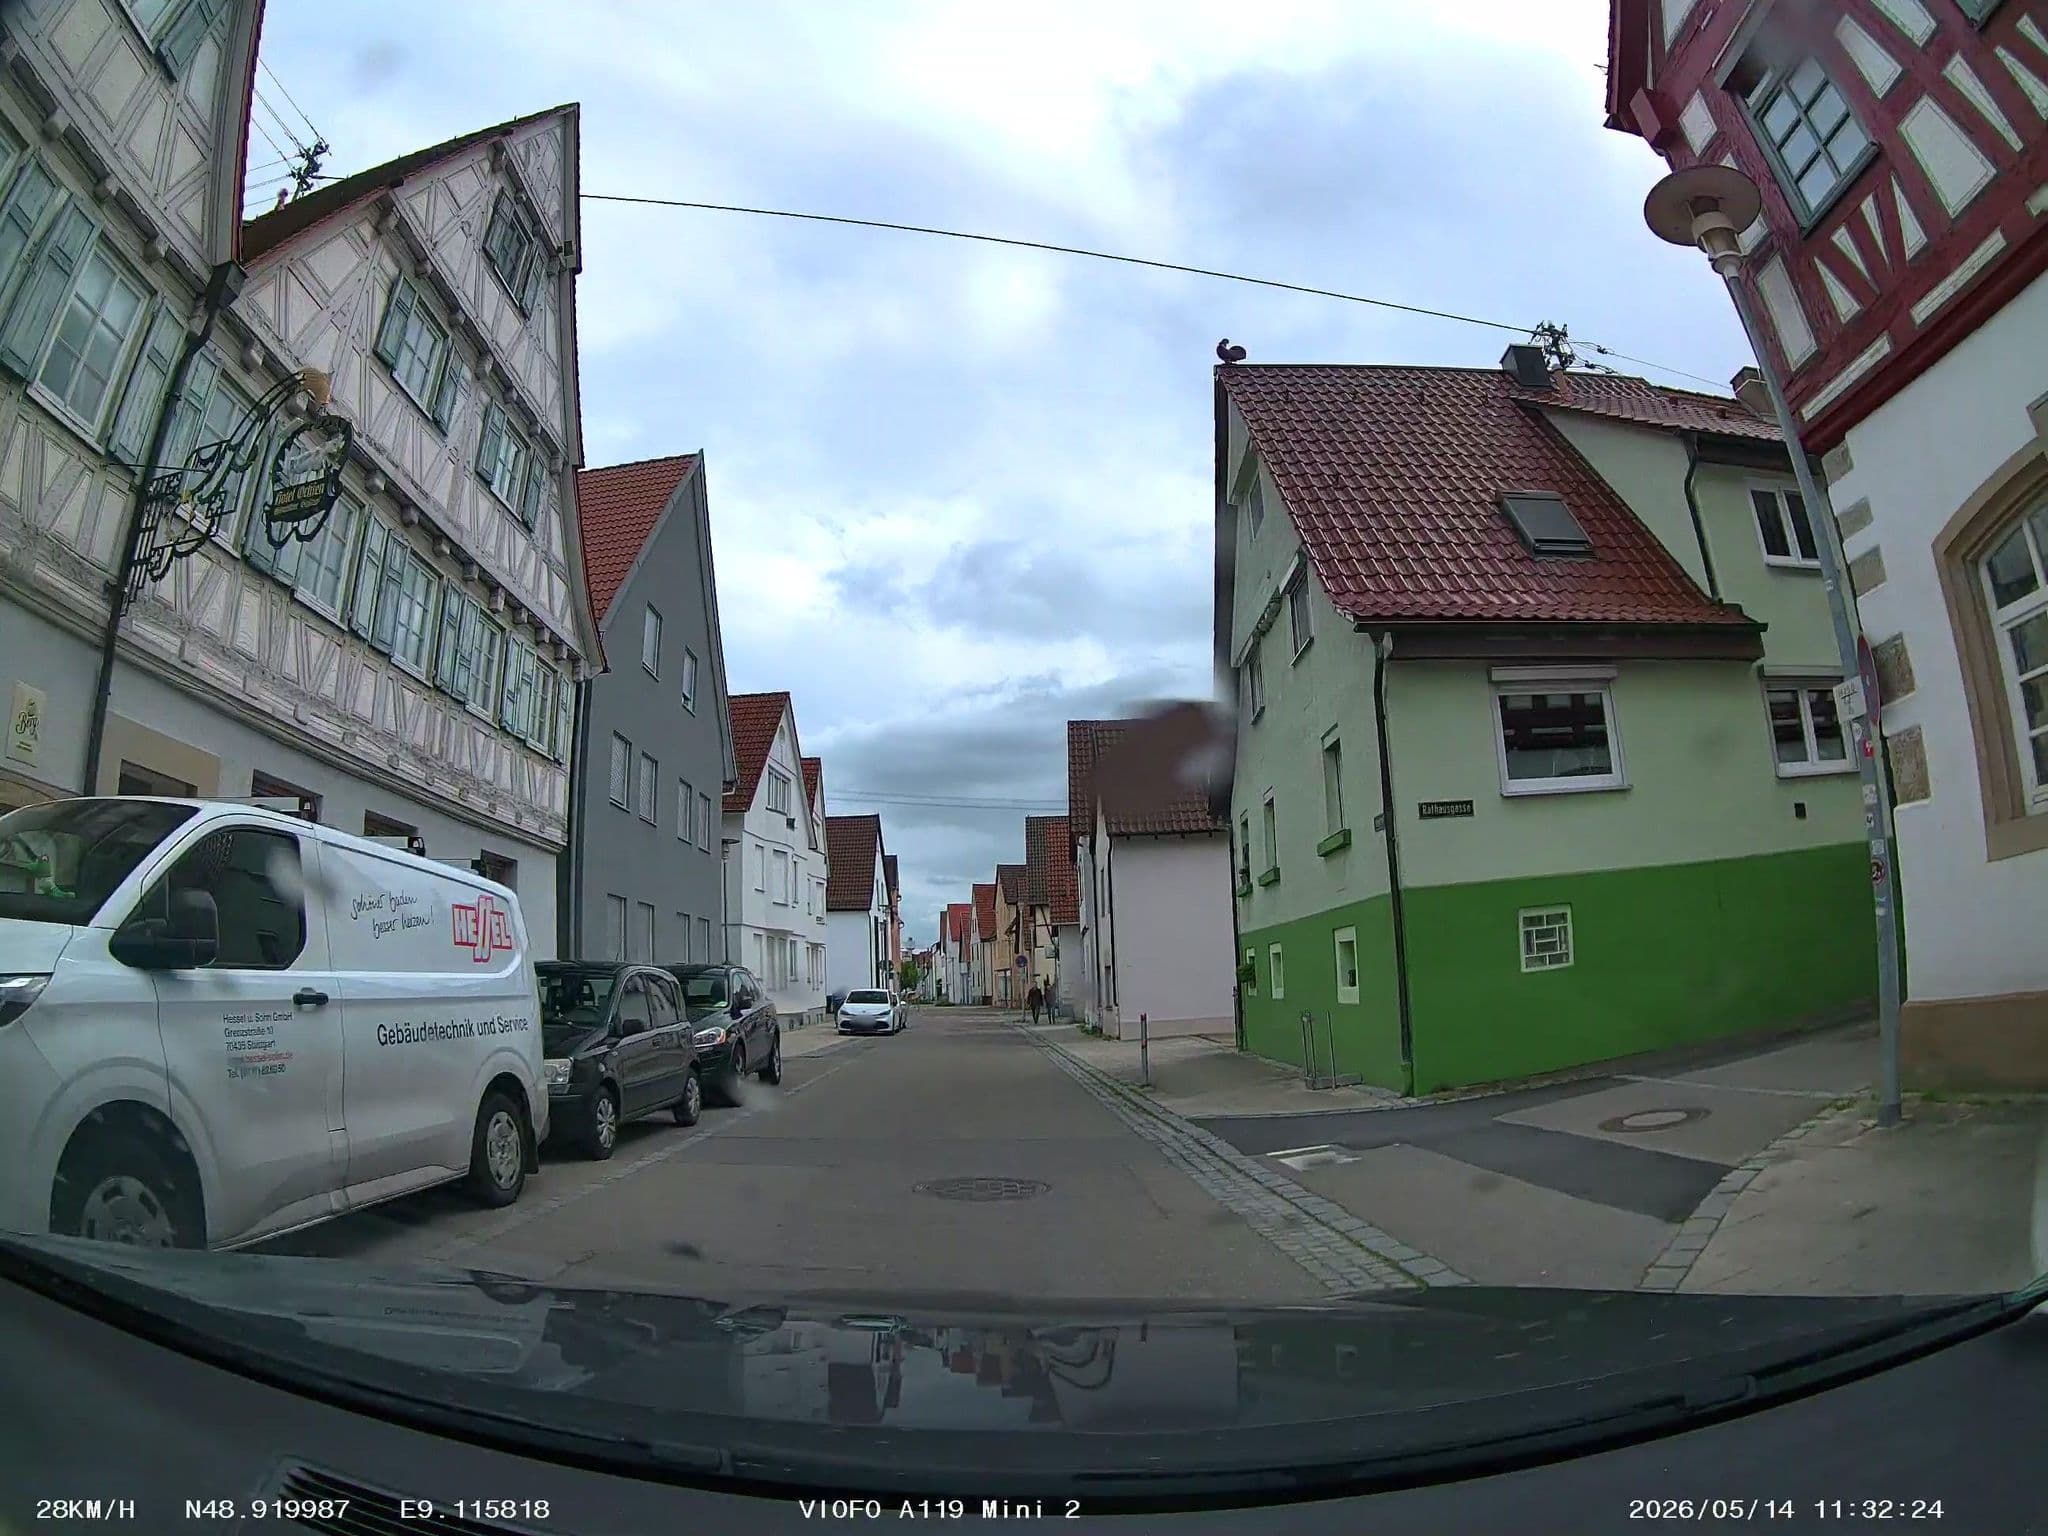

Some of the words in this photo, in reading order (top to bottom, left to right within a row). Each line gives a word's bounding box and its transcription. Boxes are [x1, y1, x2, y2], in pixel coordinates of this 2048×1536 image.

[1422, 803, 1472, 815] Rathausgasse
[377, 1018, 474, 1046] Gebäudetechnik
[477, 1016, 497, 1036] und
[496, 1015, 529, 1034] Service
